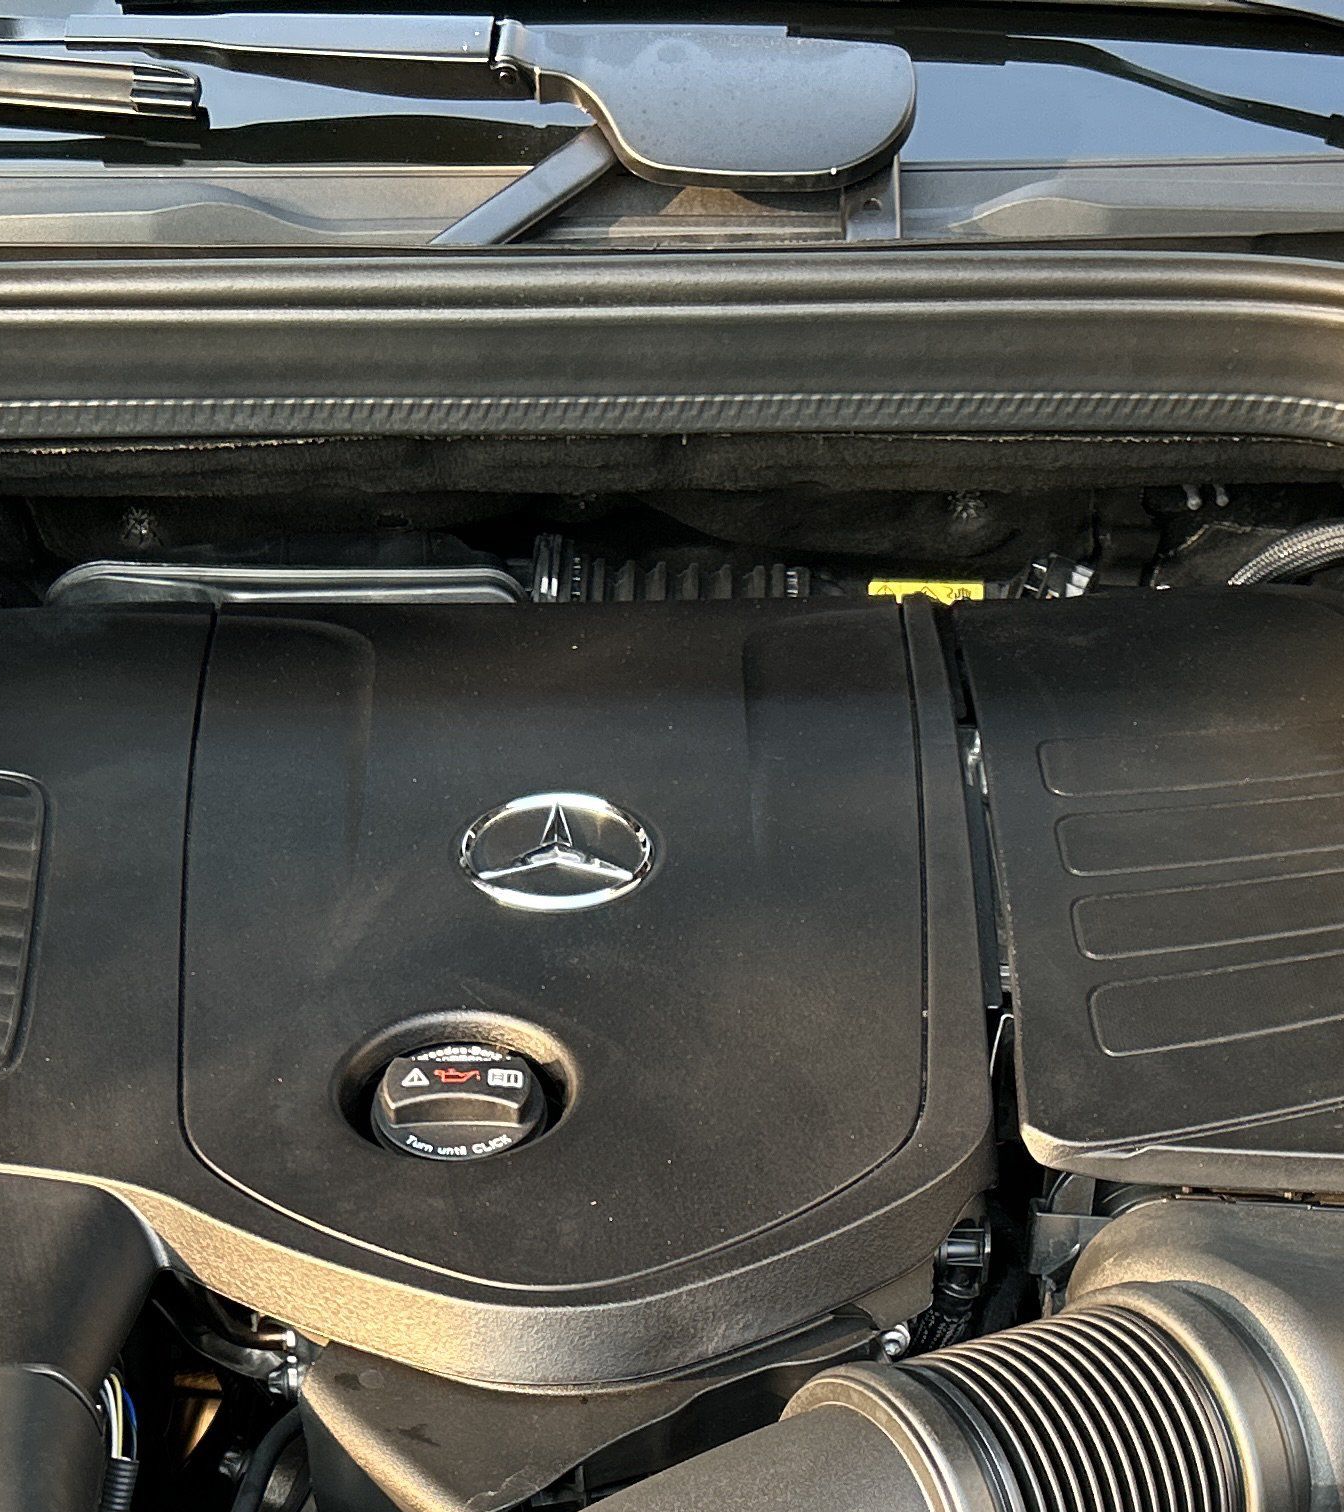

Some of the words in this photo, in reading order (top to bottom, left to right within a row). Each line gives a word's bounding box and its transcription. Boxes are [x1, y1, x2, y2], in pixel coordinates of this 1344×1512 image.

[406, 1134, 434, 1153] Turn
[437, 1145, 467, 1156] until
[471, 1134, 512, 1154] CLICK
